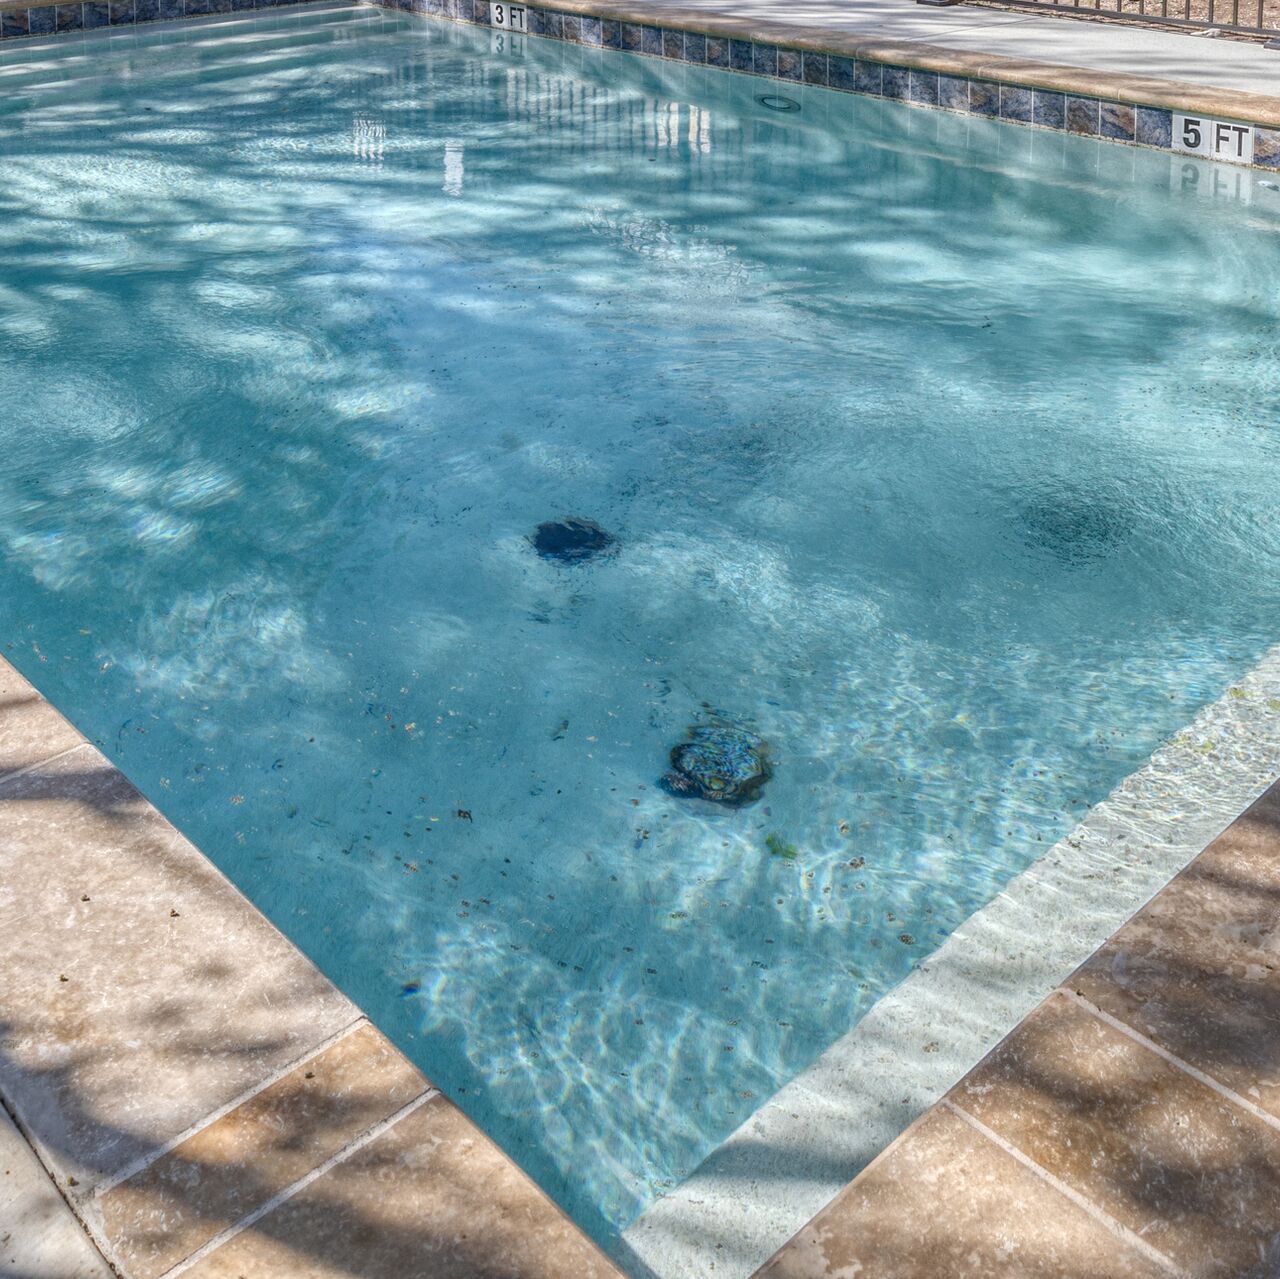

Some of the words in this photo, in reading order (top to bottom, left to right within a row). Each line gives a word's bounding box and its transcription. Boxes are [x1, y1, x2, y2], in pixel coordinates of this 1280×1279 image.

[495, 4, 504, 25] 3
[509, 6, 525, 28] FT
[1182, 118, 1201, 148] 5
[1215, 123, 1249, 157] FT
